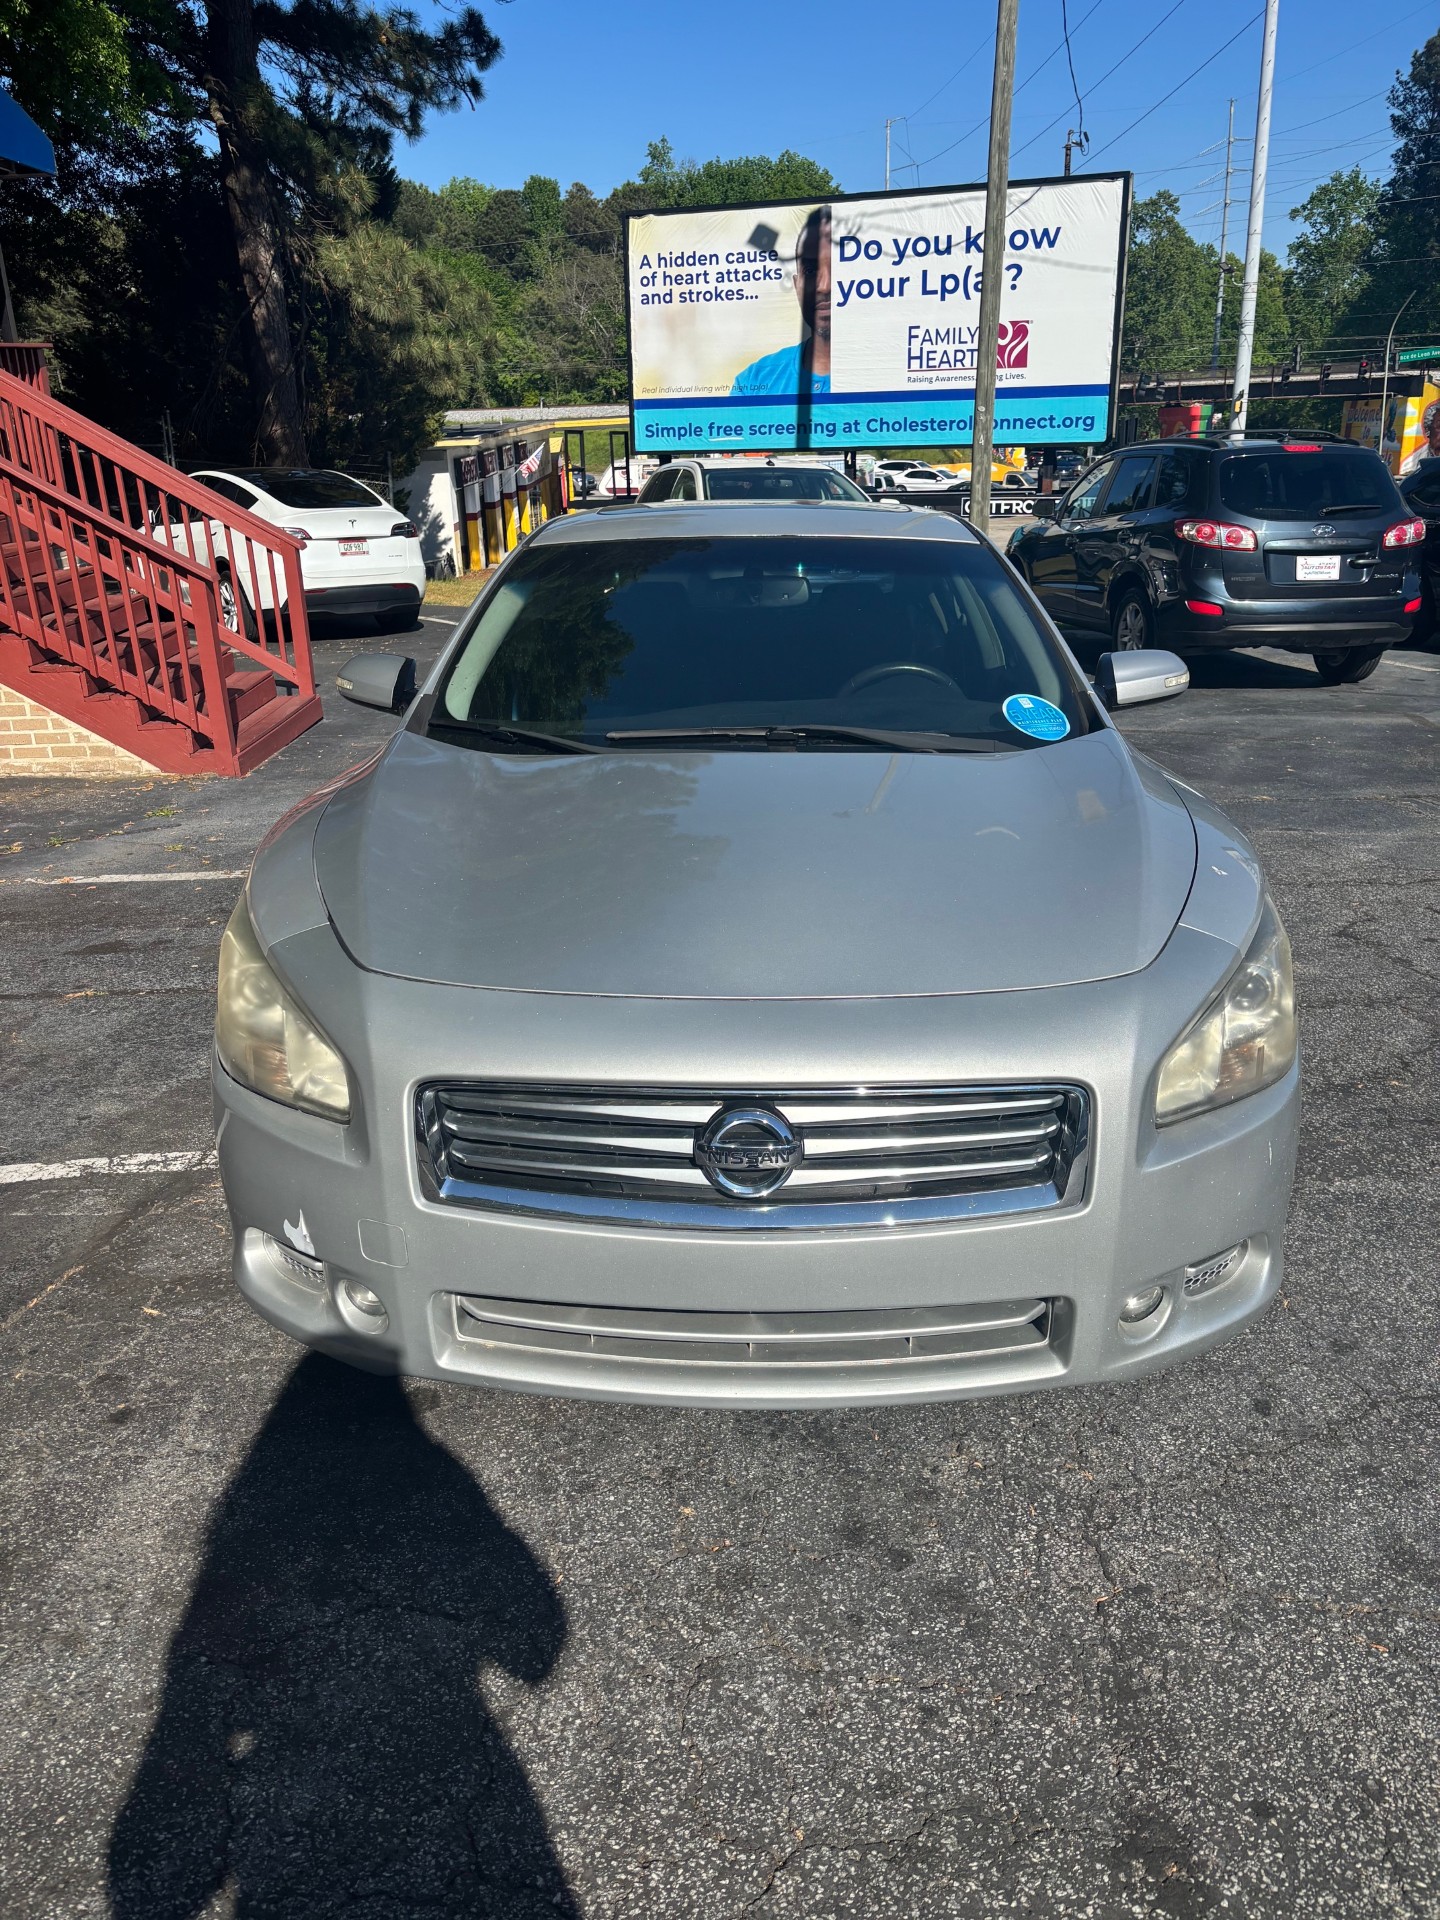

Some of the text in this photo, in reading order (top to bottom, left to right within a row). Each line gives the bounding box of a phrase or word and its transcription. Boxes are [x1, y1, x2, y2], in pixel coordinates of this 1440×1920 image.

[839, 225, 1062, 266] Do you kow
[639, 249, 779, 269] A hidden cause
[640, 265, 783, 287] of heart attacks
[836, 263, 1023, 308] your Lp(a?
[640, 286, 759, 305] and strokes...
[907, 346, 979, 370] HEART
[641, 386, 657, 394] Real
[658, 385, 695, 394] individual
[694, 385, 713, 394] living
[714, 384, 730, 392] with
[731, 383, 748, 393] high
[907, 376, 934, 384] Raising
[645, 414, 1096, 441] Simple free screening at Cholesterolnnect.org
[1008, 707, 1060, 721] 5 YEAR
[707, 1149, 790, 1165] NISSAN
